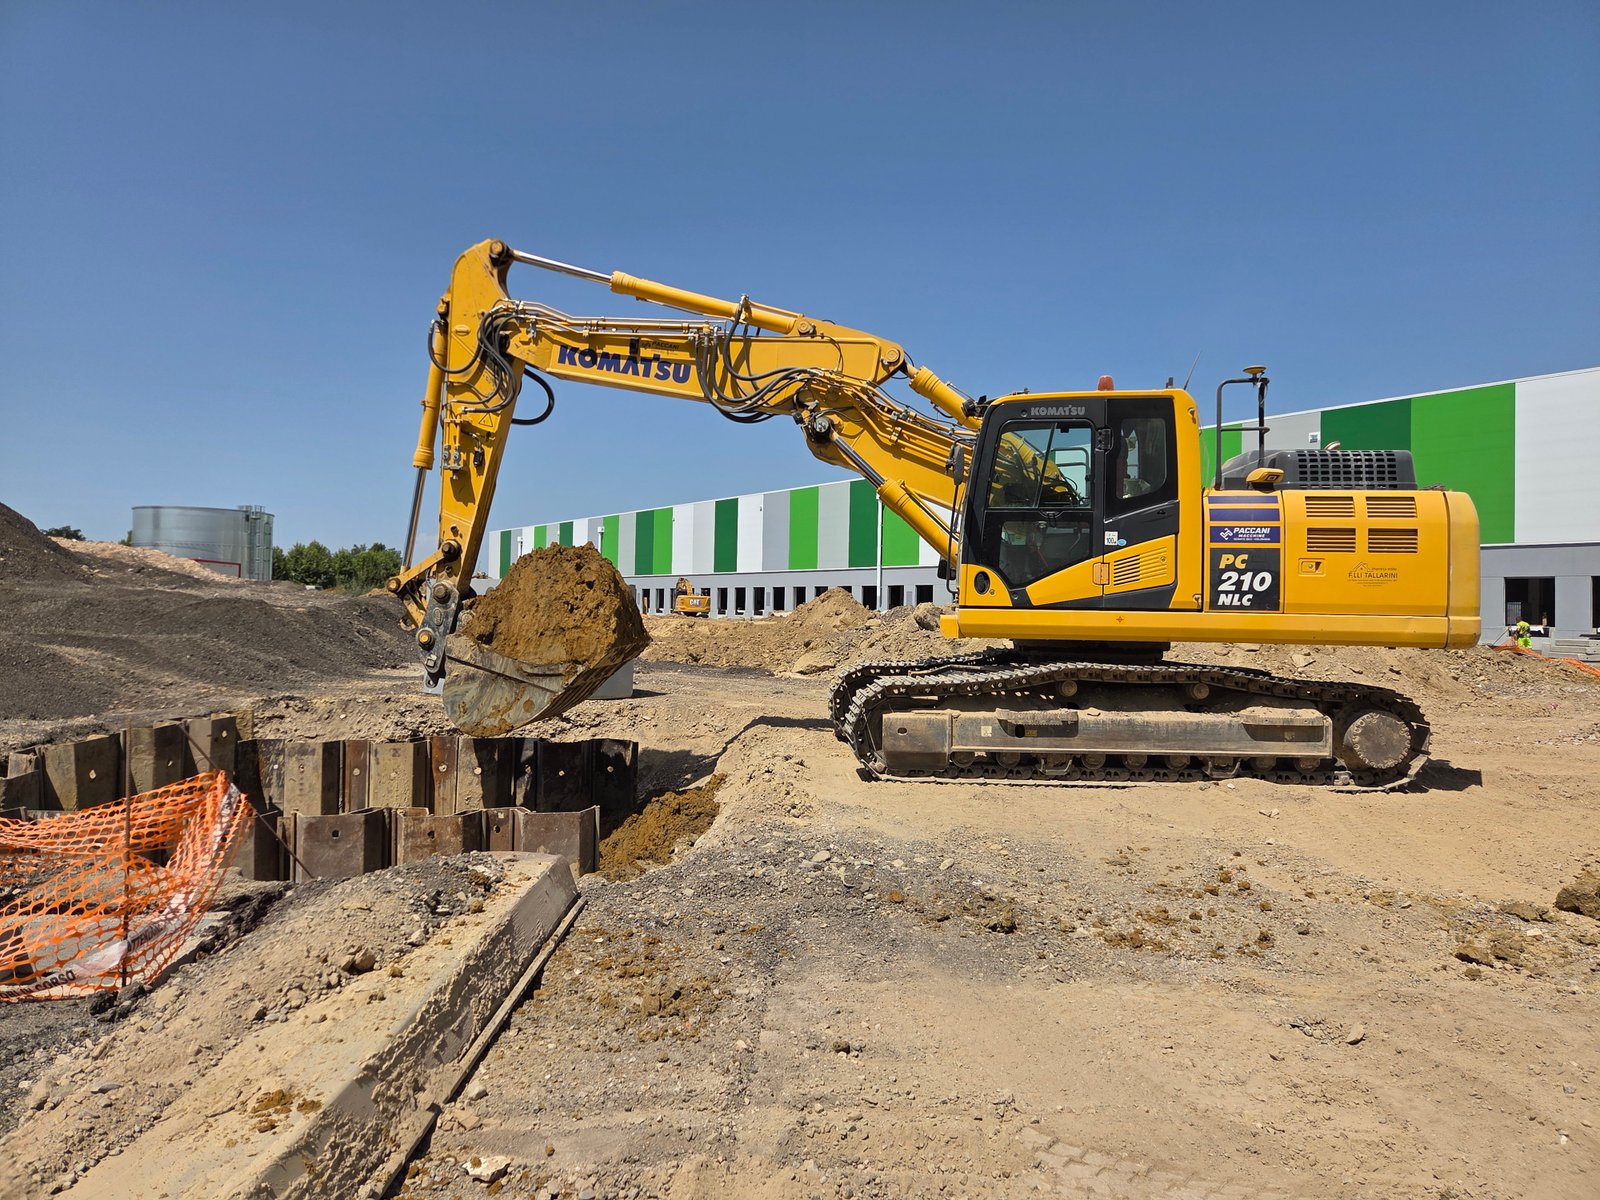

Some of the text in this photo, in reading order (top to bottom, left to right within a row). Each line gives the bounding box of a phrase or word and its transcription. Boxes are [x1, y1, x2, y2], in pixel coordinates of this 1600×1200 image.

[558, 345, 691, 384] KOMATSU
[1031, 404, 1086, 416] KOMATSU
[1218, 554, 1249, 569] PC
[1217, 571, 1273, 592] 210
[1217, 594, 1253, 606] NLC
[35, 969, 77, 991] CORSO
